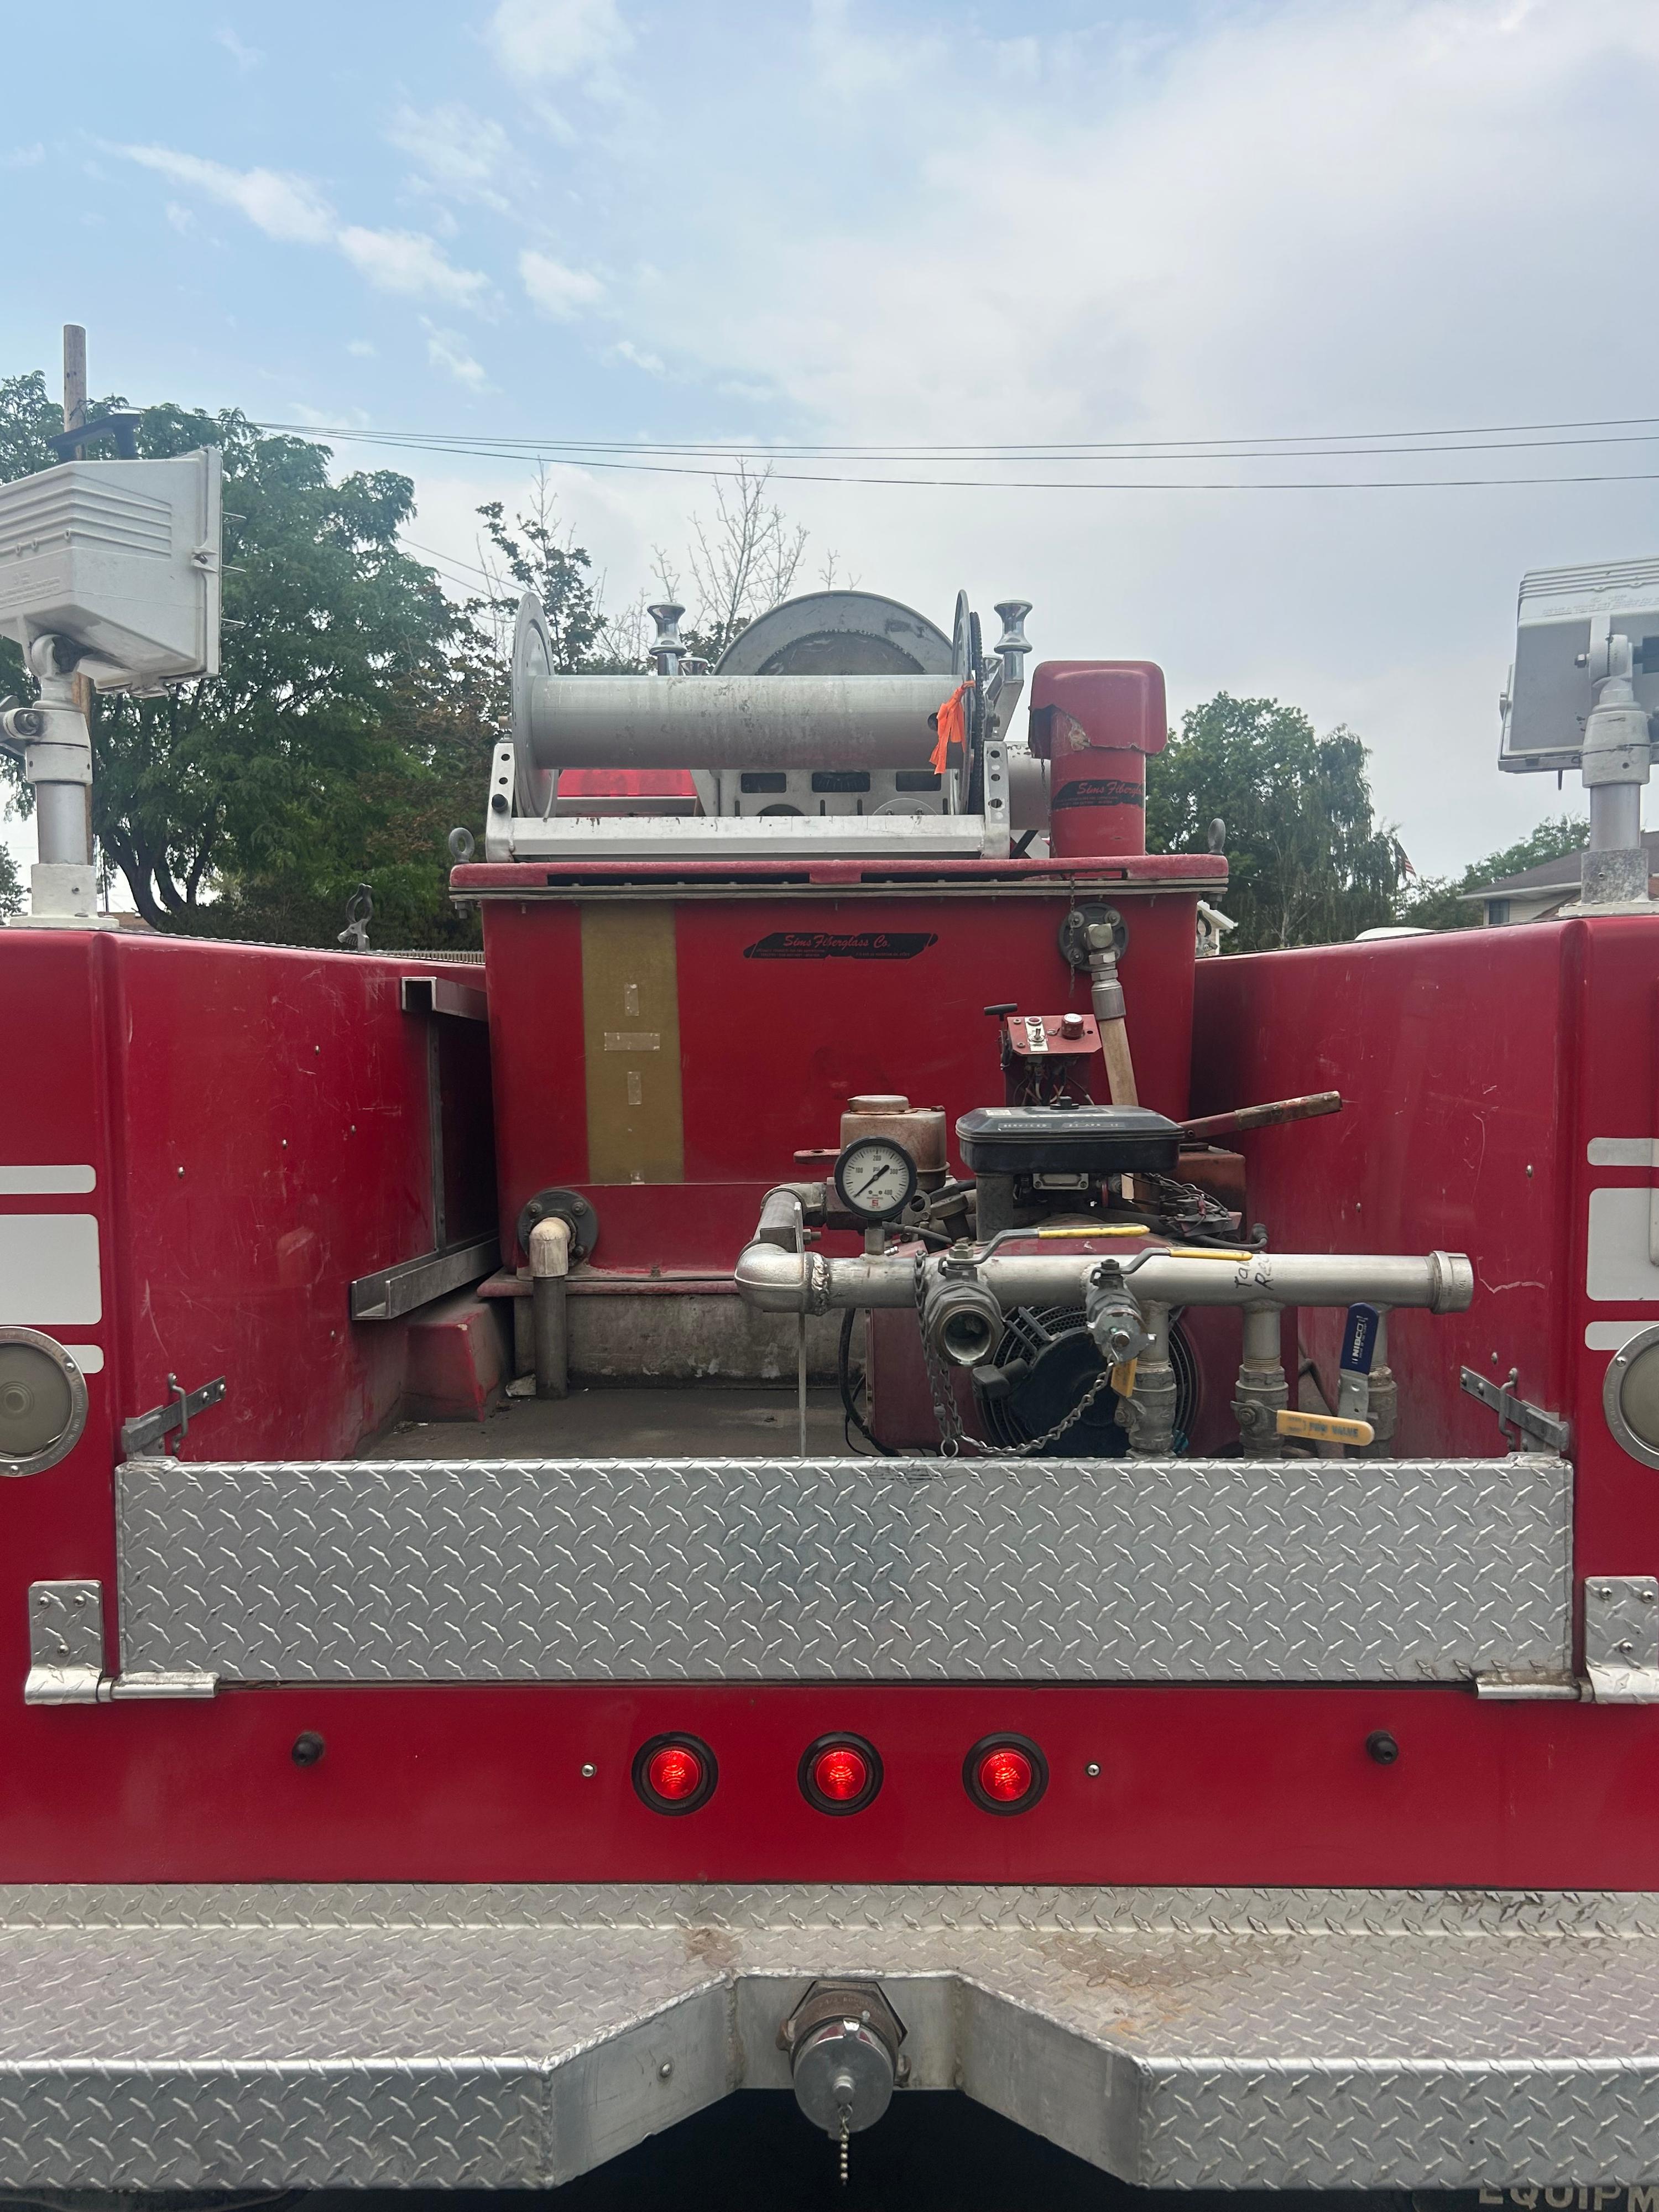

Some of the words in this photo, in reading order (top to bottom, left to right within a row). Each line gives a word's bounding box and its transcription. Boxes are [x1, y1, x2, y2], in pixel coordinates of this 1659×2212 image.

[1077, 782, 1104, 795] Sims
[784, 935, 812, 946] Sims
[813, 935, 869, 951] Fiberglass
[874, 935, 890, 948] Co.
[1352, 1322, 1364, 1357] NIBCO
